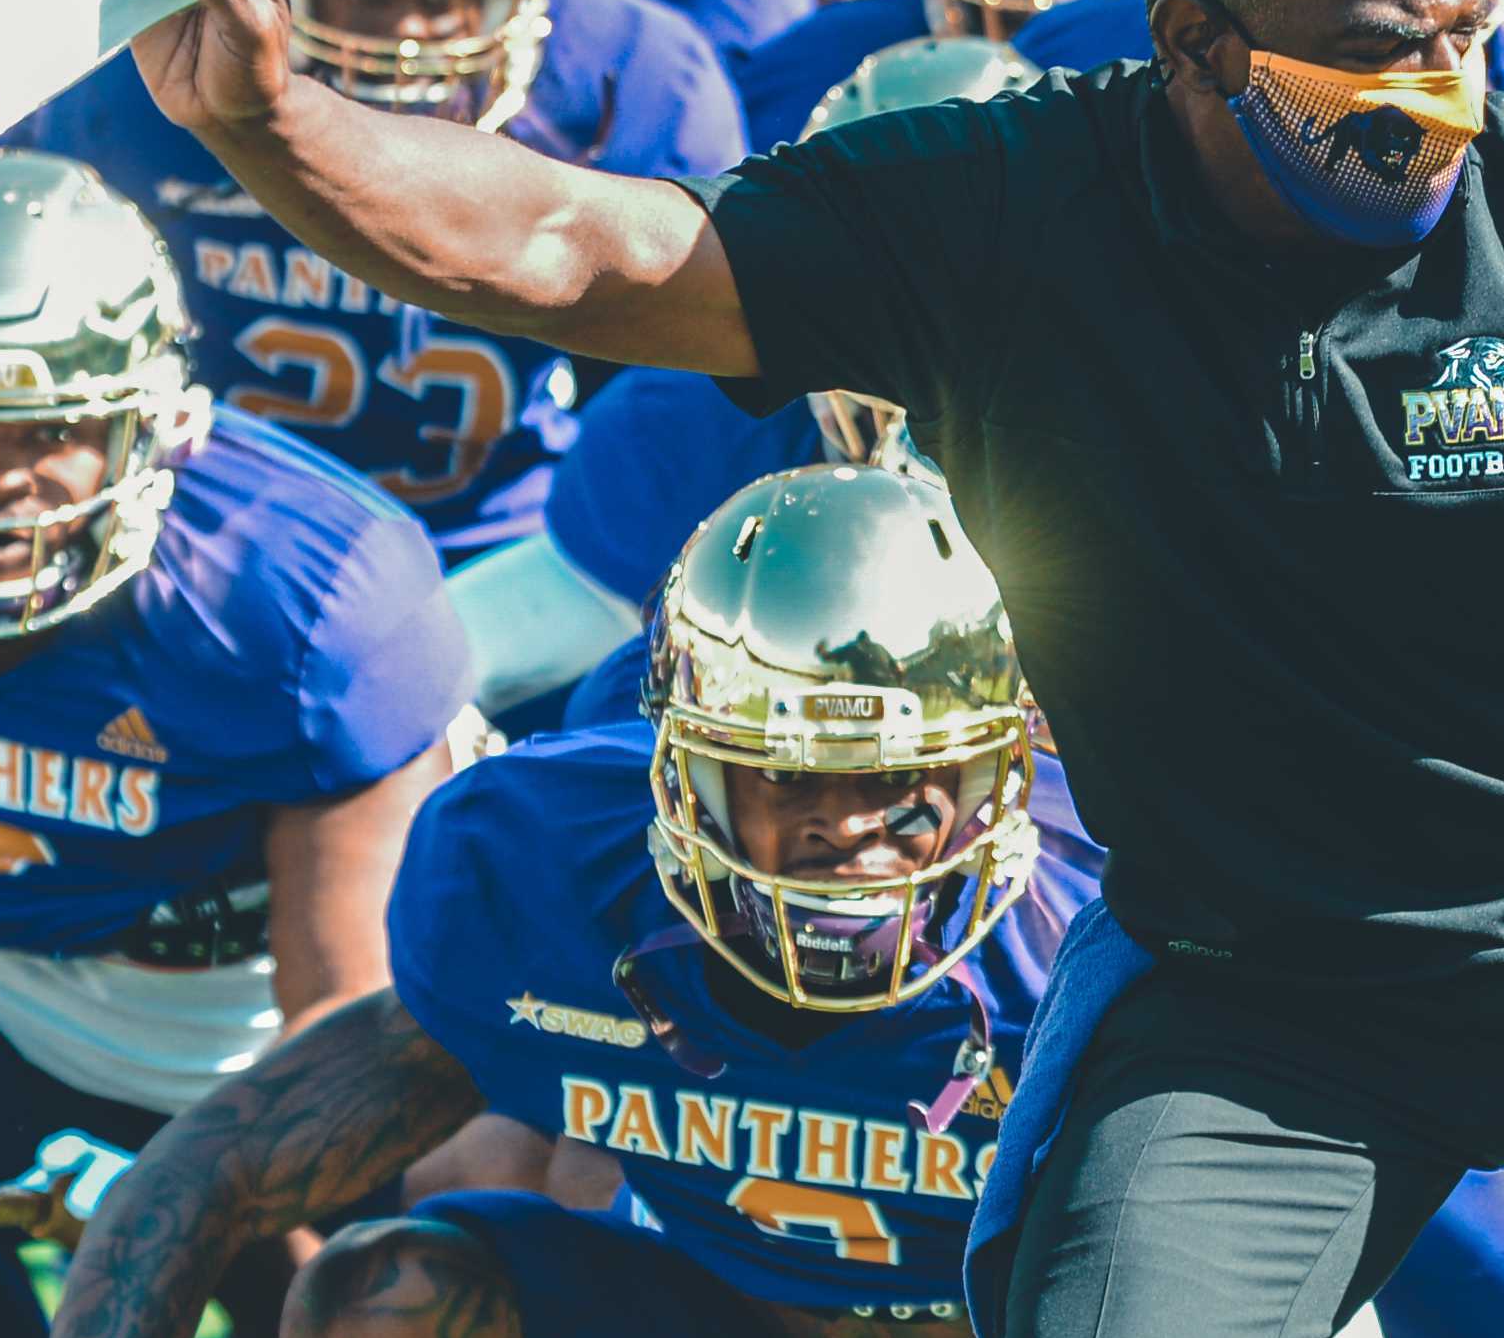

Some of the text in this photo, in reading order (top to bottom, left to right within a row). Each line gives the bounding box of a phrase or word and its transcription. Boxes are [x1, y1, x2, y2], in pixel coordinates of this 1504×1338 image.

[814, 697, 874, 718] PVAMU
[796, 931, 849, 953] Riddell
[540, 1006, 648, 1048] SWAC
